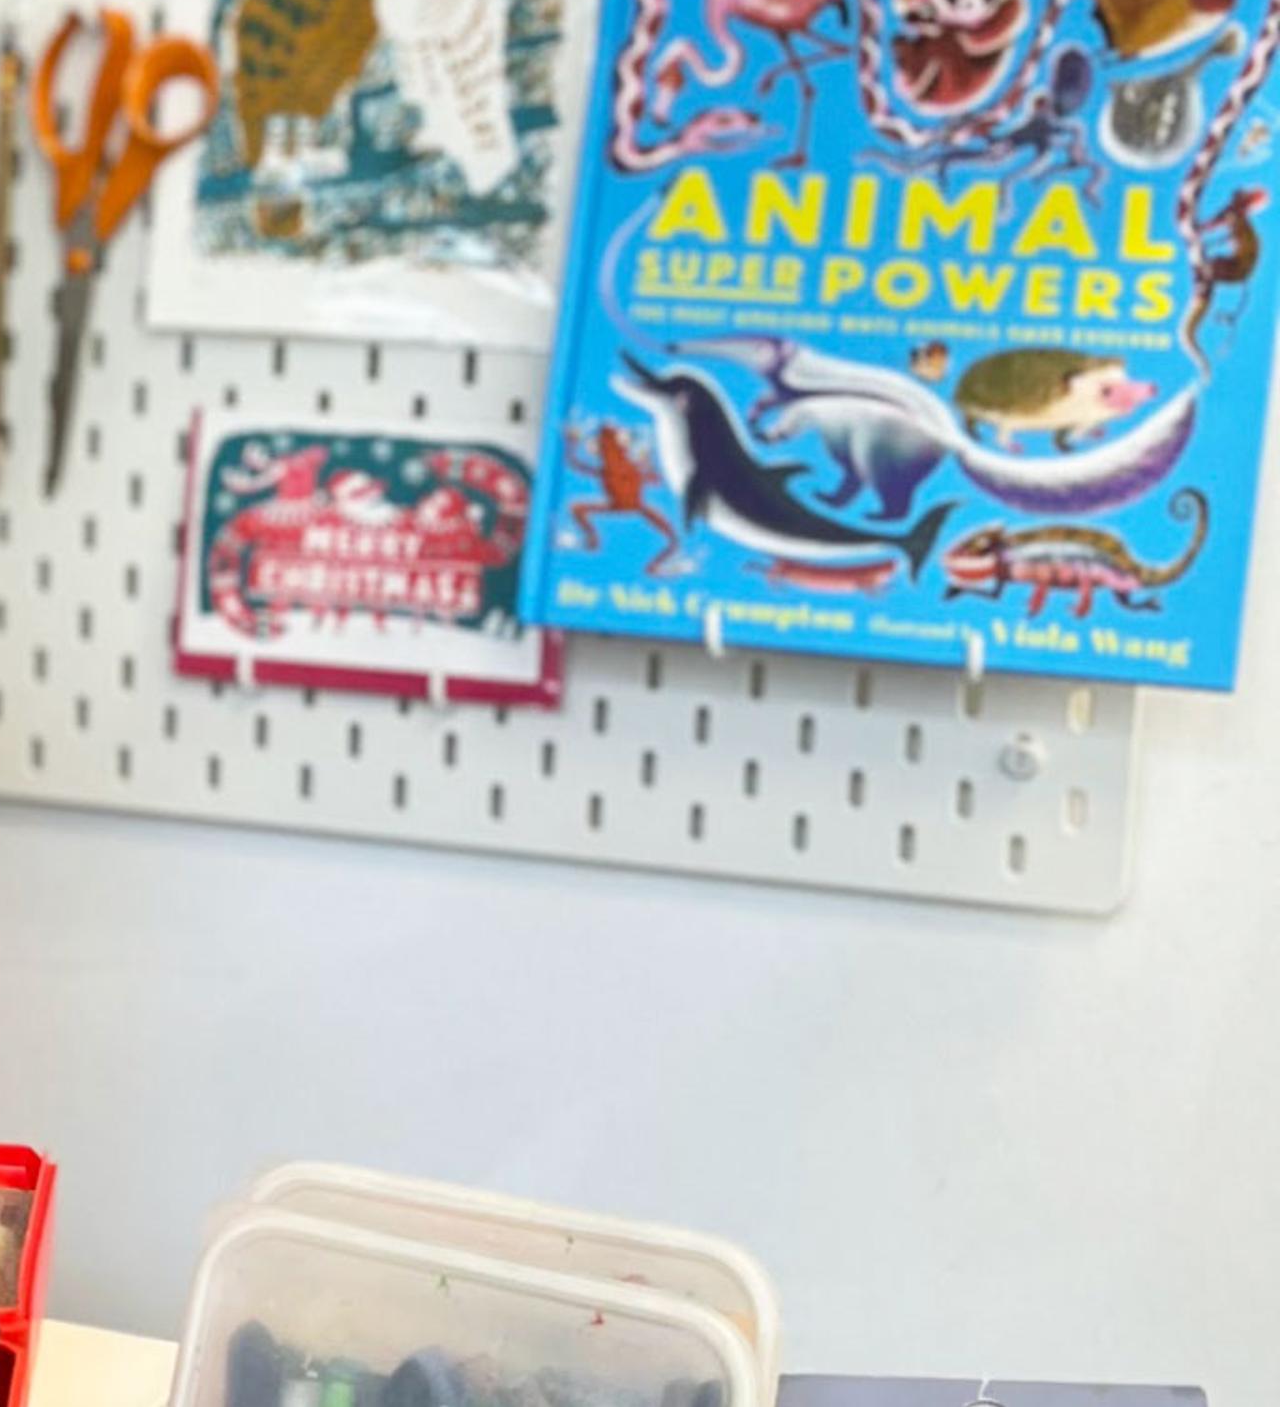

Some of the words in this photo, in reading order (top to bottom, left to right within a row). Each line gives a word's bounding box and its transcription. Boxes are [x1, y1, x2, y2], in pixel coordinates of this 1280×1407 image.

[647, 168, 1176, 262] ANIMAL
[637, 247, 804, 290] SUPER
[820, 256, 1175, 322] POWERS
